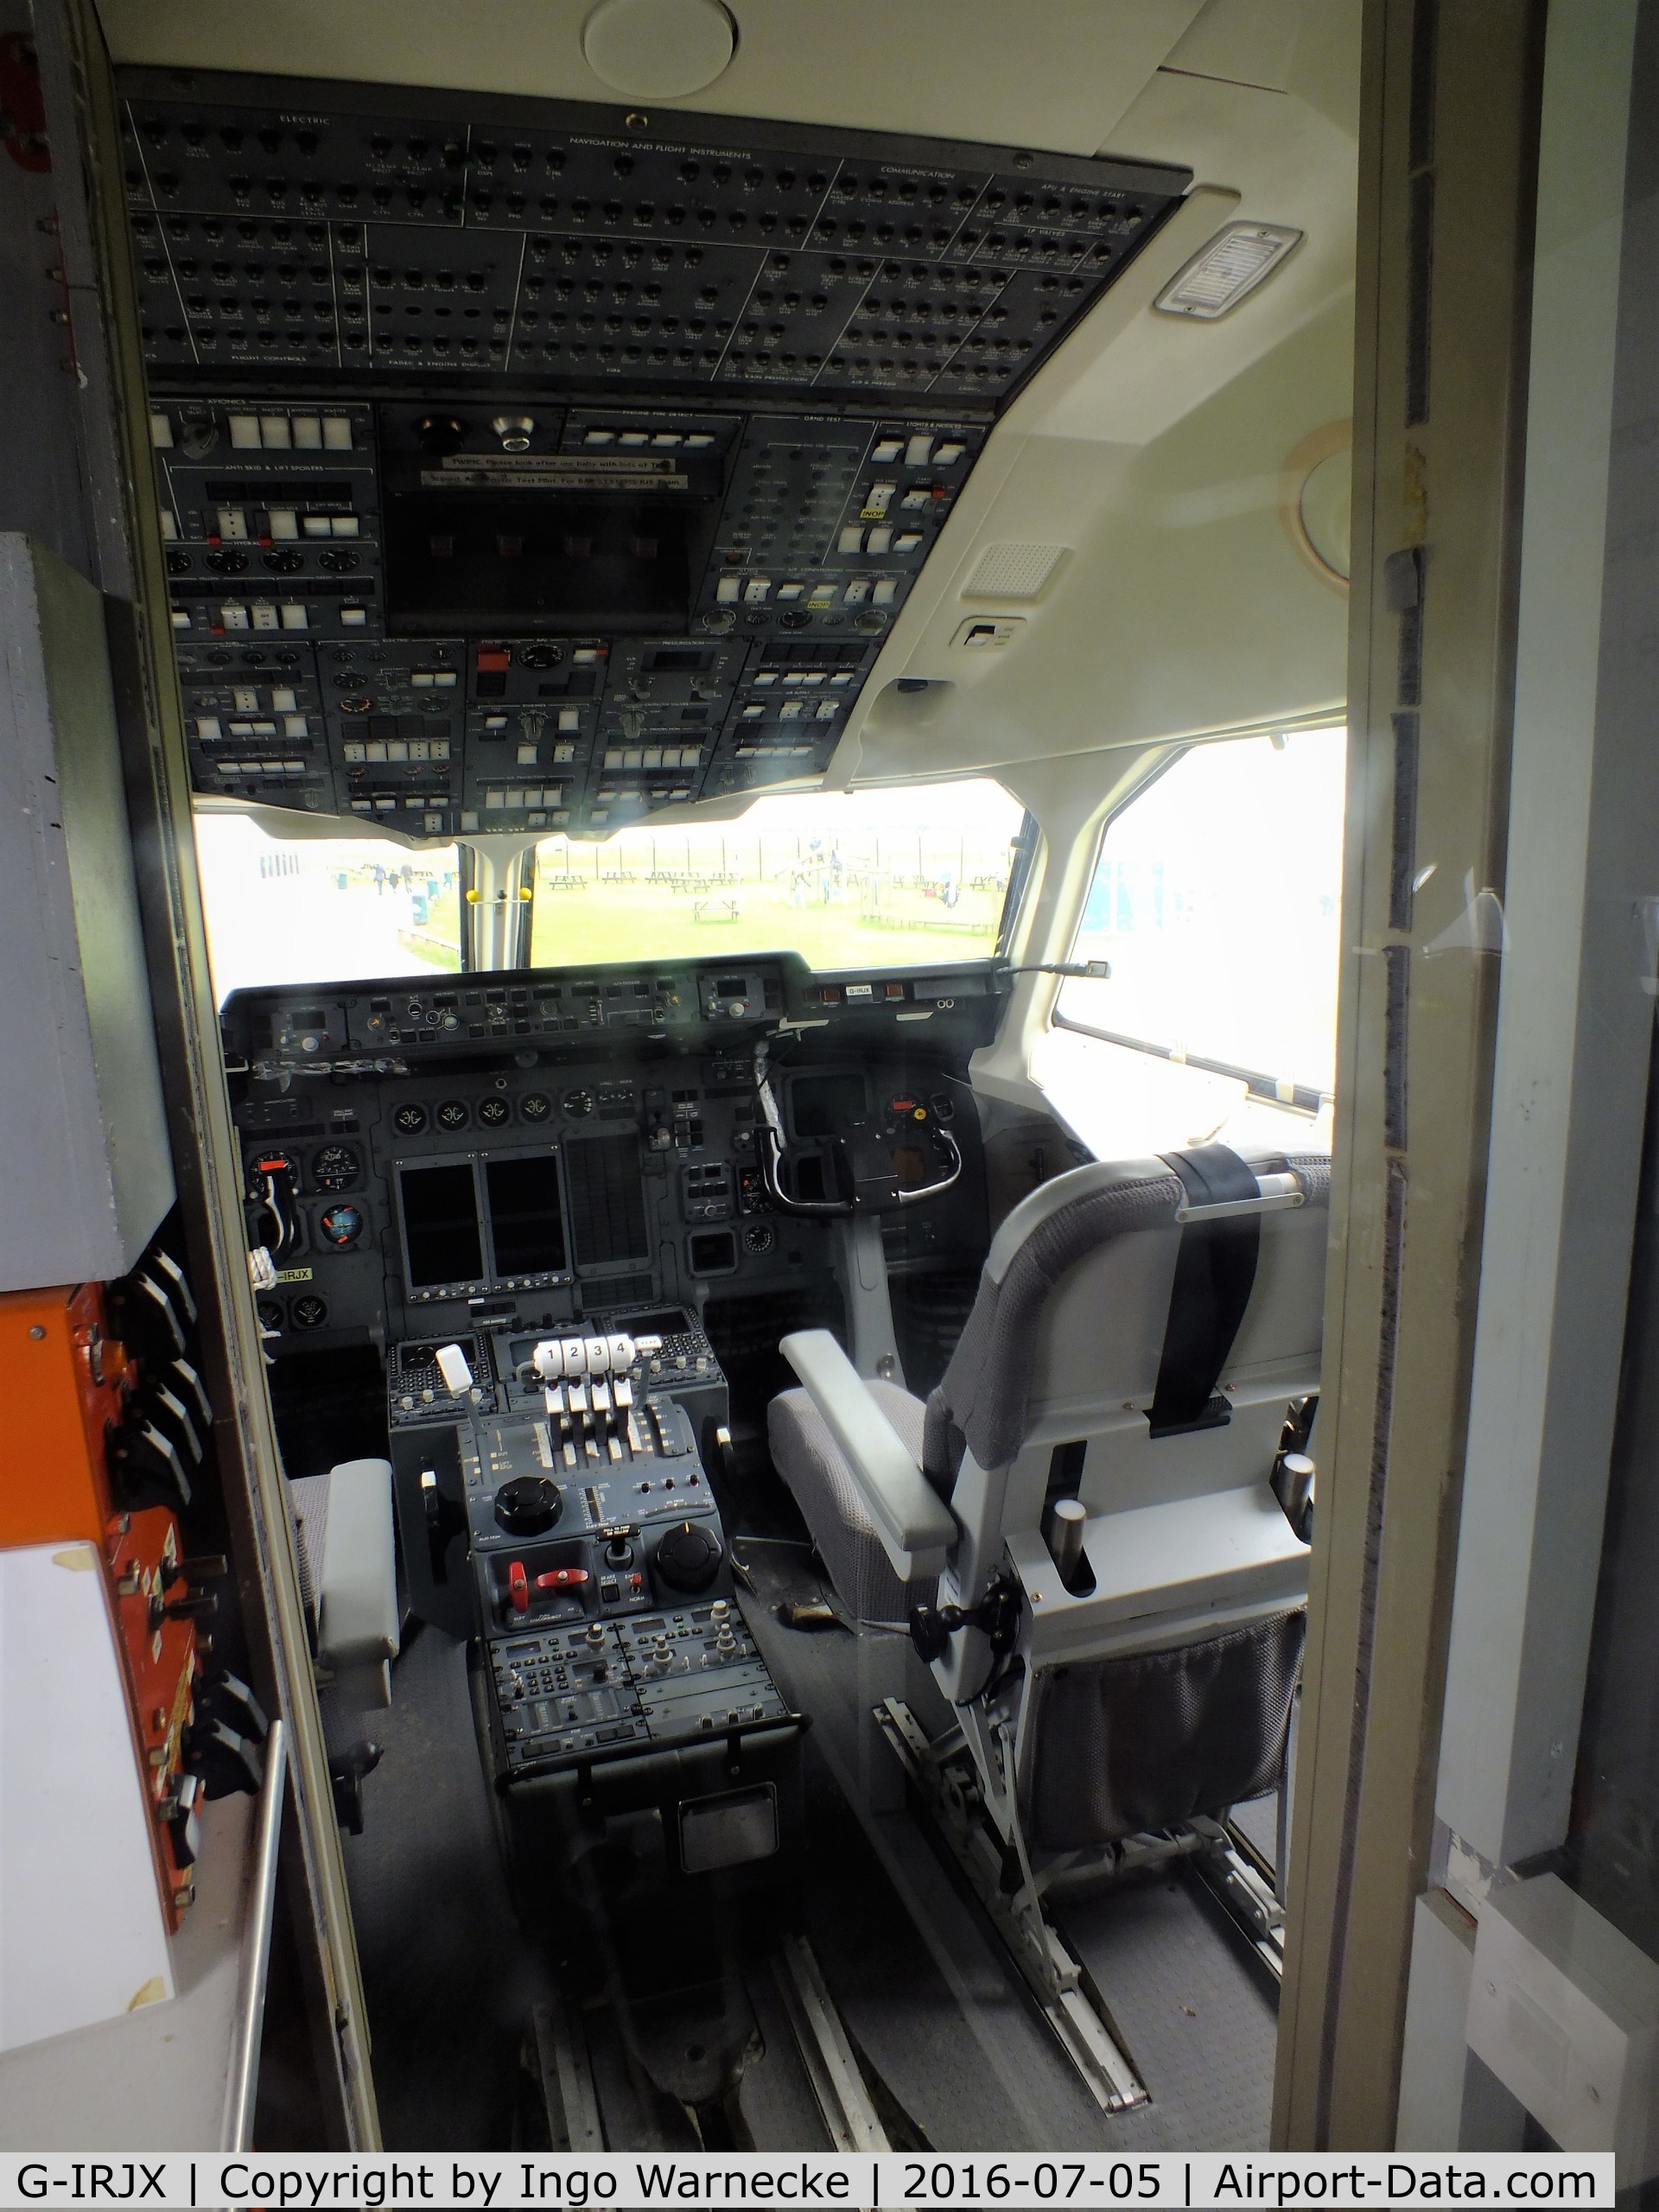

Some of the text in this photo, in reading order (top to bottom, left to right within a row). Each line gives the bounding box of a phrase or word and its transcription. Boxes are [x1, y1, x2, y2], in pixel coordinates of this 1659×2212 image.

[279, 115, 330, 125] ELECTRIC
[569, 137, 629, 149] NAVIGATION
[655, 145, 686, 154] FLIGHT
[690, 148, 752, 159] INSTRUMENTS
[880, 165, 955, 180] COMMUNICATION
[1069, 188, 1100, 197] ENGINE
[1103, 191, 1126, 200] START
[277, 1268, 309, 1281] -IRJX
[548, 1343, 626, 1359] 1 2 3 4
